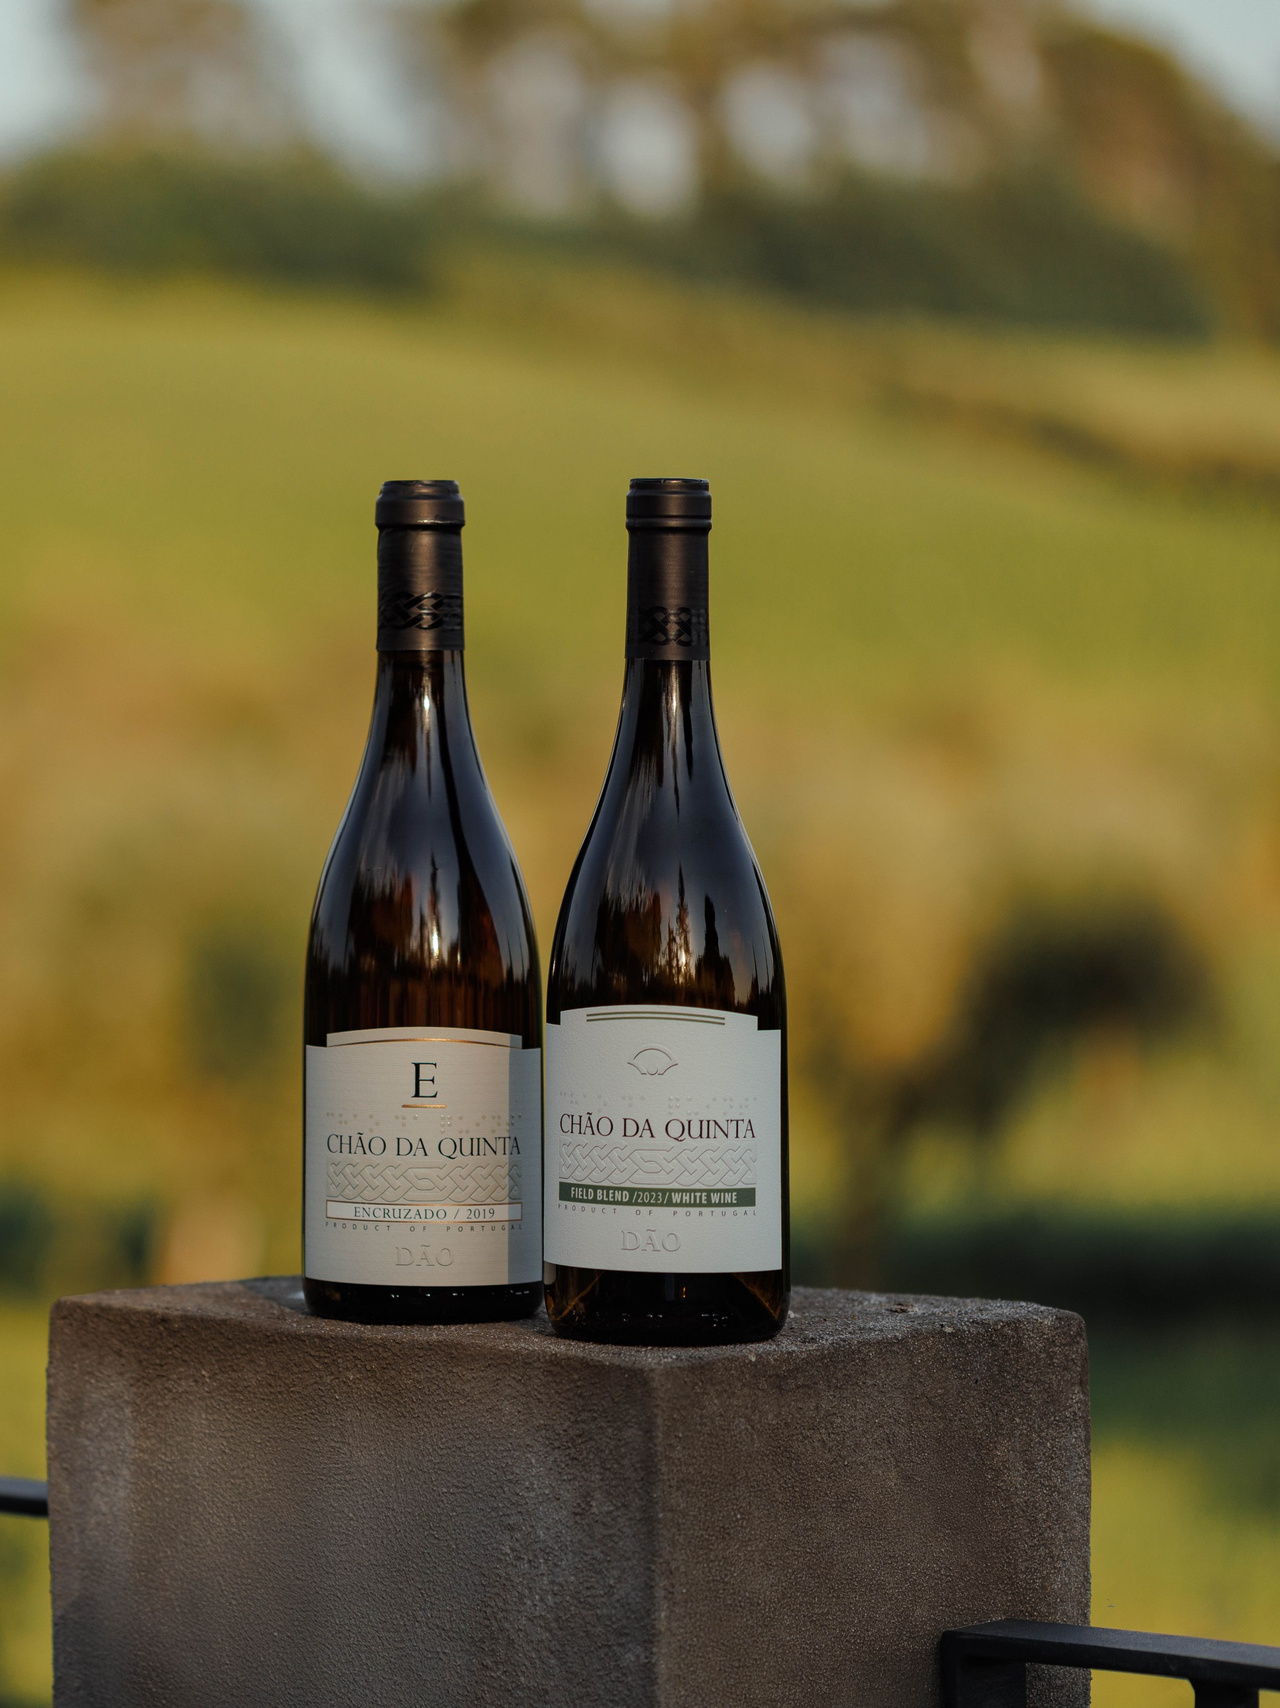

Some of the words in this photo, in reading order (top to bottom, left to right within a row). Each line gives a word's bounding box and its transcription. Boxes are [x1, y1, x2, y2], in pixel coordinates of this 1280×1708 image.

[411, 1062, 438, 1098] E
[560, 1112, 614, 1136] CHÃO
[622, 1118, 655, 1138] DA
[665, 1119, 756, 1142] QUINTA
[327, 1132, 387, 1156] CHÃO
[396, 1137, 428, 1157] DA
[438, 1136, 521, 1159] QUINTA
[570, 1187, 594, 1199] FIELD
[596, 1188, 629, 1201] BLEND
[671, 1192, 708, 1204] WHITE
[711, 1192, 737, 1204] WINE
[354, 1207, 447, 1219] ENCRUZADO
[466, 1208, 495, 1219] 2019
[558, 1204, 617, 1215] PRODUCT
[326, 1222, 391, 1231] PRODUCT
[447, 1224, 522, 1232] PORTUGAL
[621, 1229, 681, 1252] DÃO
[395, 1245, 454, 1267] DÃO
